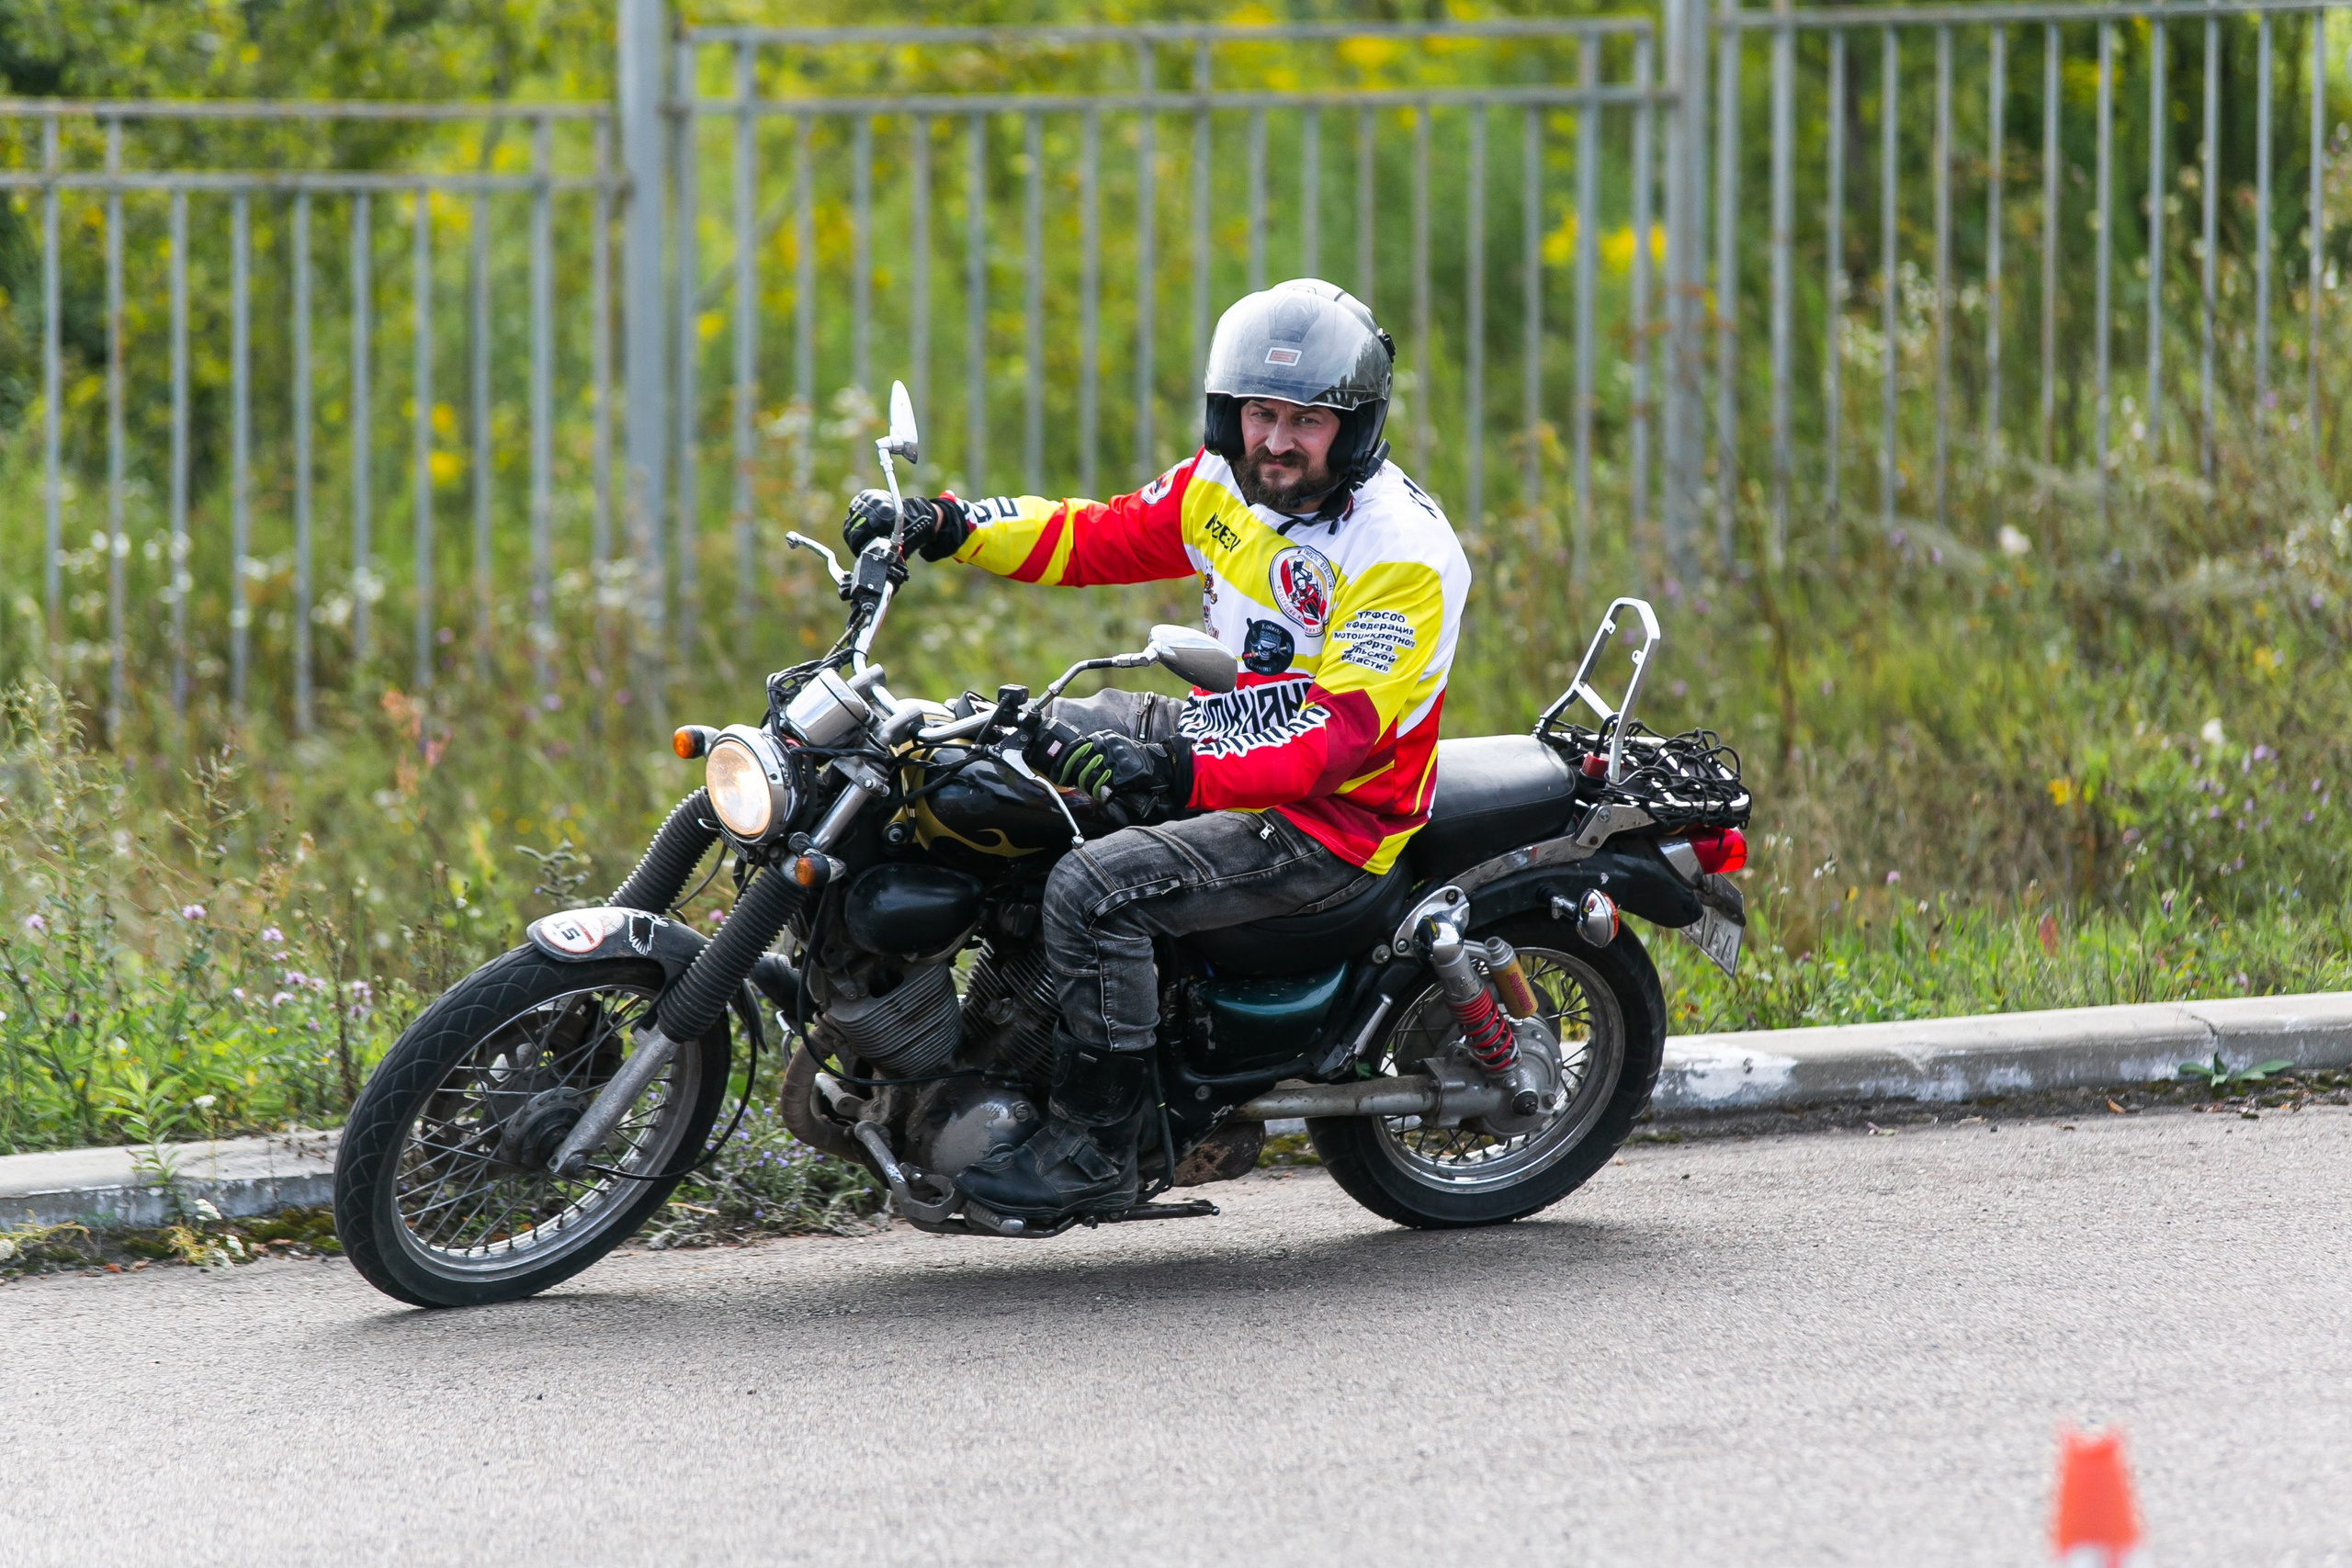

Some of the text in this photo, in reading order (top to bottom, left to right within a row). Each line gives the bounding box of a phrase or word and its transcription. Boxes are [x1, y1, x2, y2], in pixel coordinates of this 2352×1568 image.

[1357, 610, 1406, 624] ТРФСОО
[1345, 621, 1414, 636] «Федерация
[1344, 646, 1396, 663] льской
